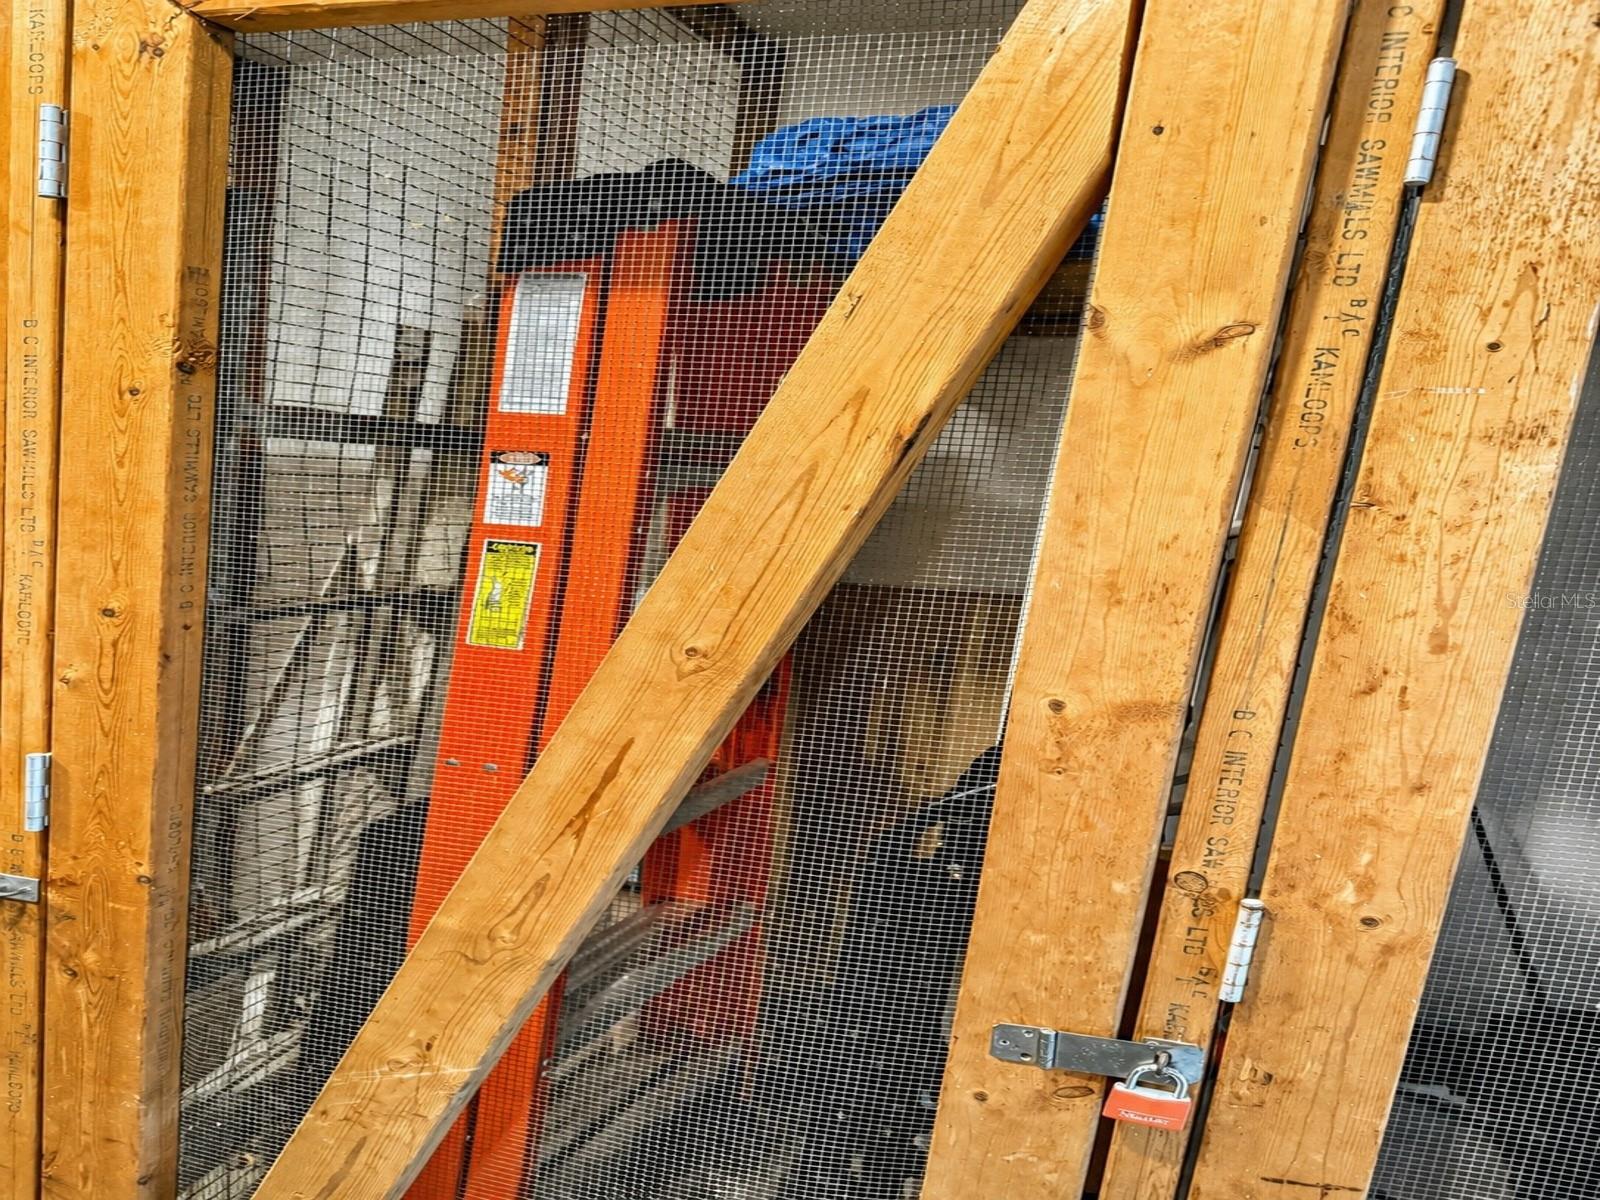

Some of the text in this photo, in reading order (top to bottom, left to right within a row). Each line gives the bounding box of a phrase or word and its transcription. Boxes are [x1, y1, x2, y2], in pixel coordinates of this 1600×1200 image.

[1366, 31, 1409, 123] INTERIOR
[1341, 139, 1385, 241] SAWMILLS
[1333, 253, 1365, 287] LTD
[23, 354, 38, 419] INTERIOR
[1209, 750, 1248, 826] INTERIOR
[1183, 926, 1209, 956] LTD
